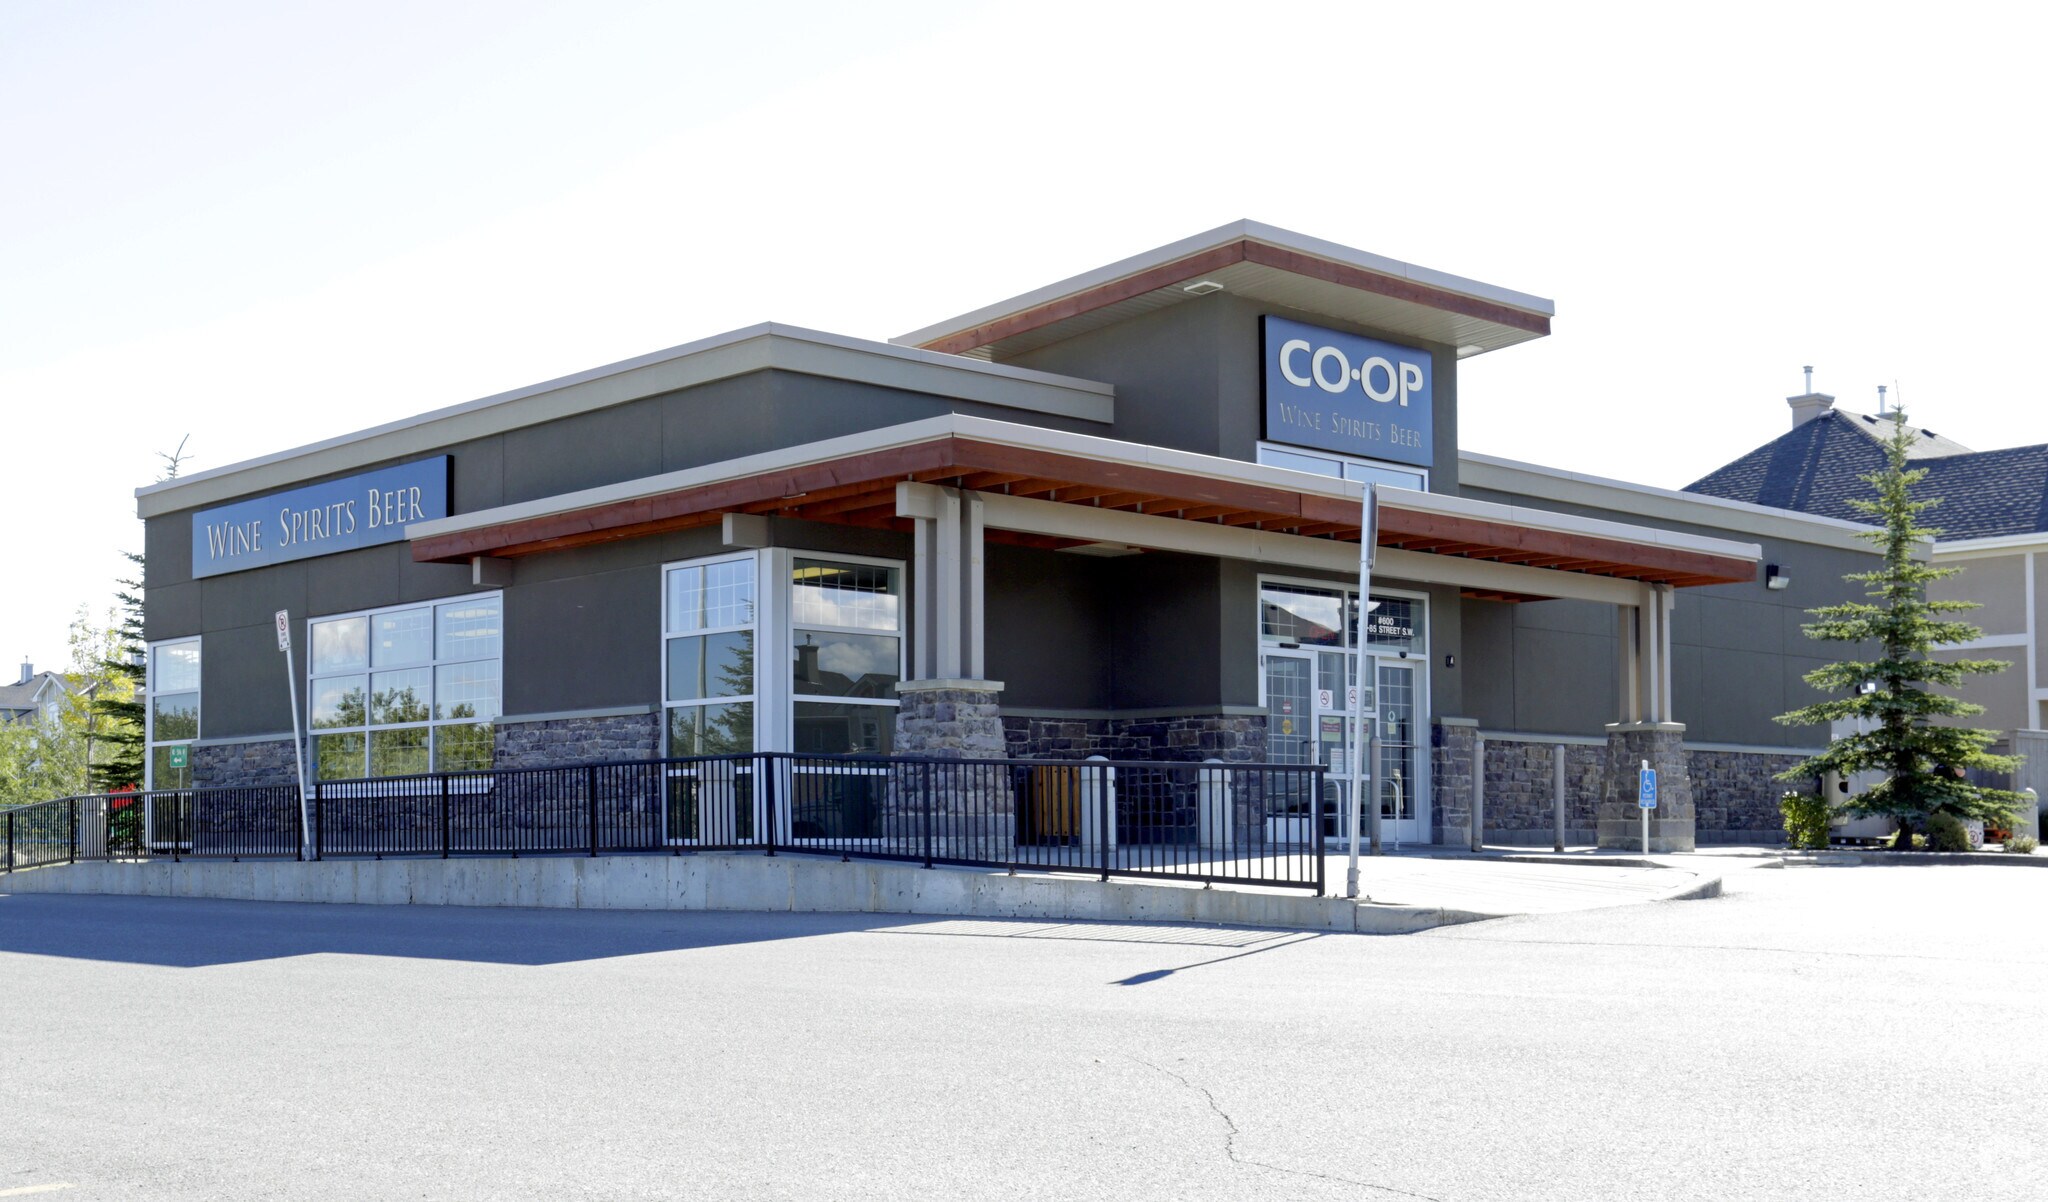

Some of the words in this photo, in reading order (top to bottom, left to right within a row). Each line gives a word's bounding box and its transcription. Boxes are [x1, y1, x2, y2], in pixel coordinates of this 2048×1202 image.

[1280, 403, 1321, 431] WINE
[1332, 412, 1381, 441] SPIRITS
[1391, 423, 1422, 448] BEER
[206, 520, 263, 561] WINE
[279, 500, 356, 547] SPIRITS
[368, 486, 425, 529] BEER
[1379, 625, 1401, 635] STREET
